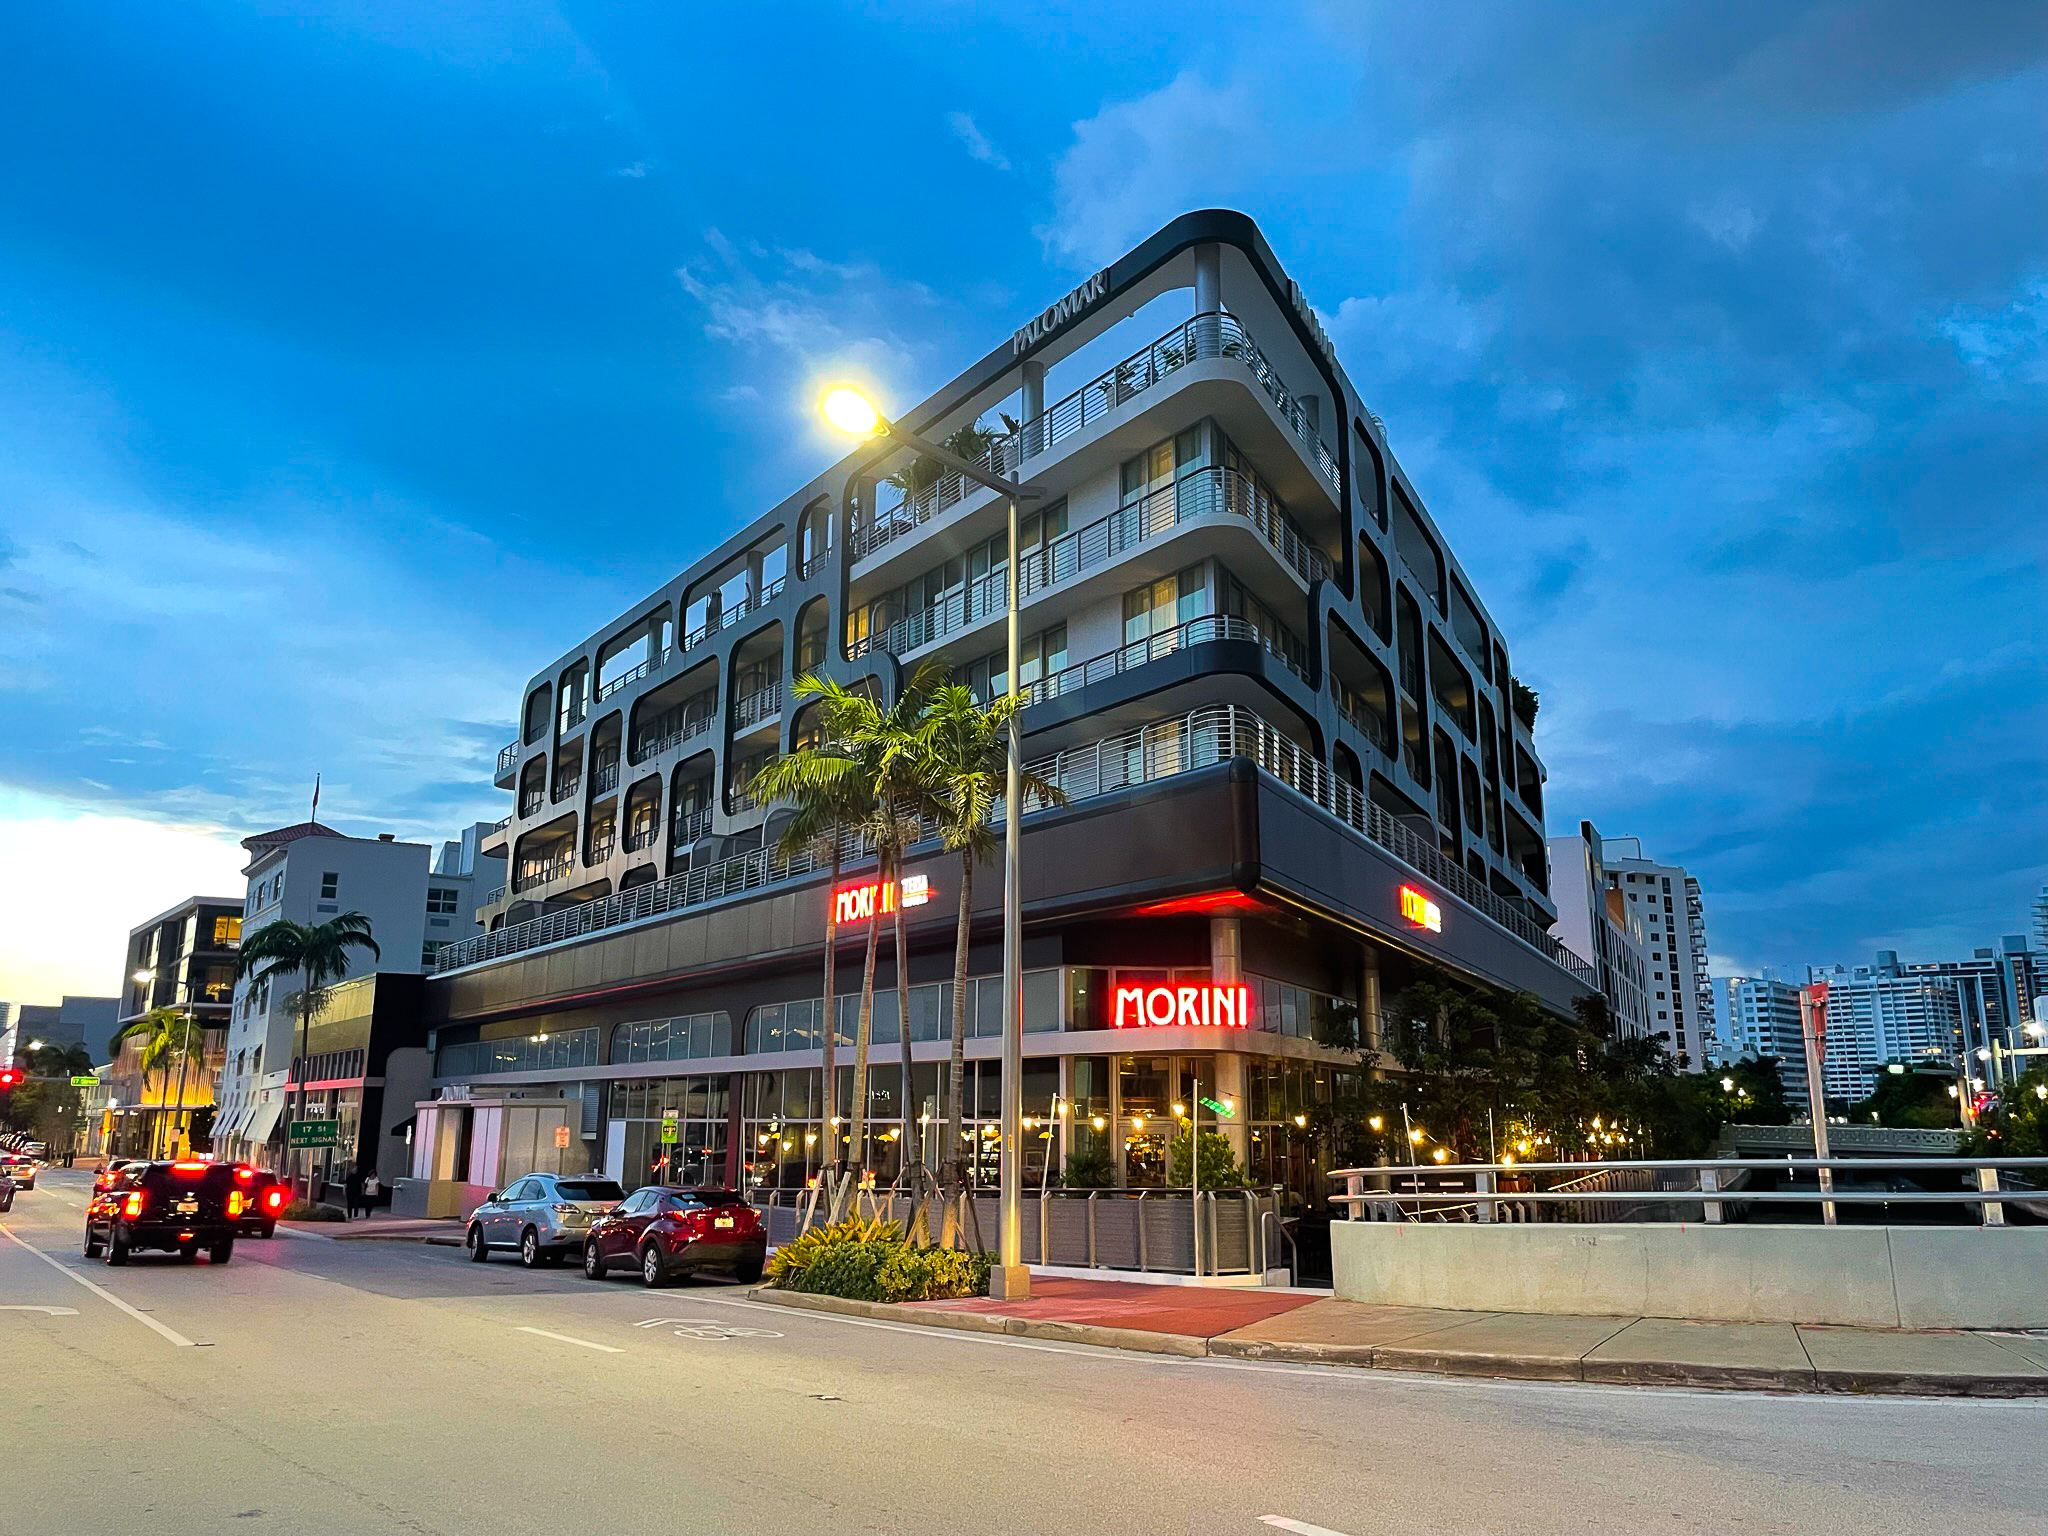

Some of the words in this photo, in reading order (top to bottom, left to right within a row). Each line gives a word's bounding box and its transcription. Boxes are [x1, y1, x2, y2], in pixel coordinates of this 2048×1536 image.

[1013, 271, 1105, 355] PALOMAR
[1115, 987, 1247, 1026] MORINI
[302, 1125, 312, 1133] 17
[311, 1136, 336, 1144] SIGNAL
